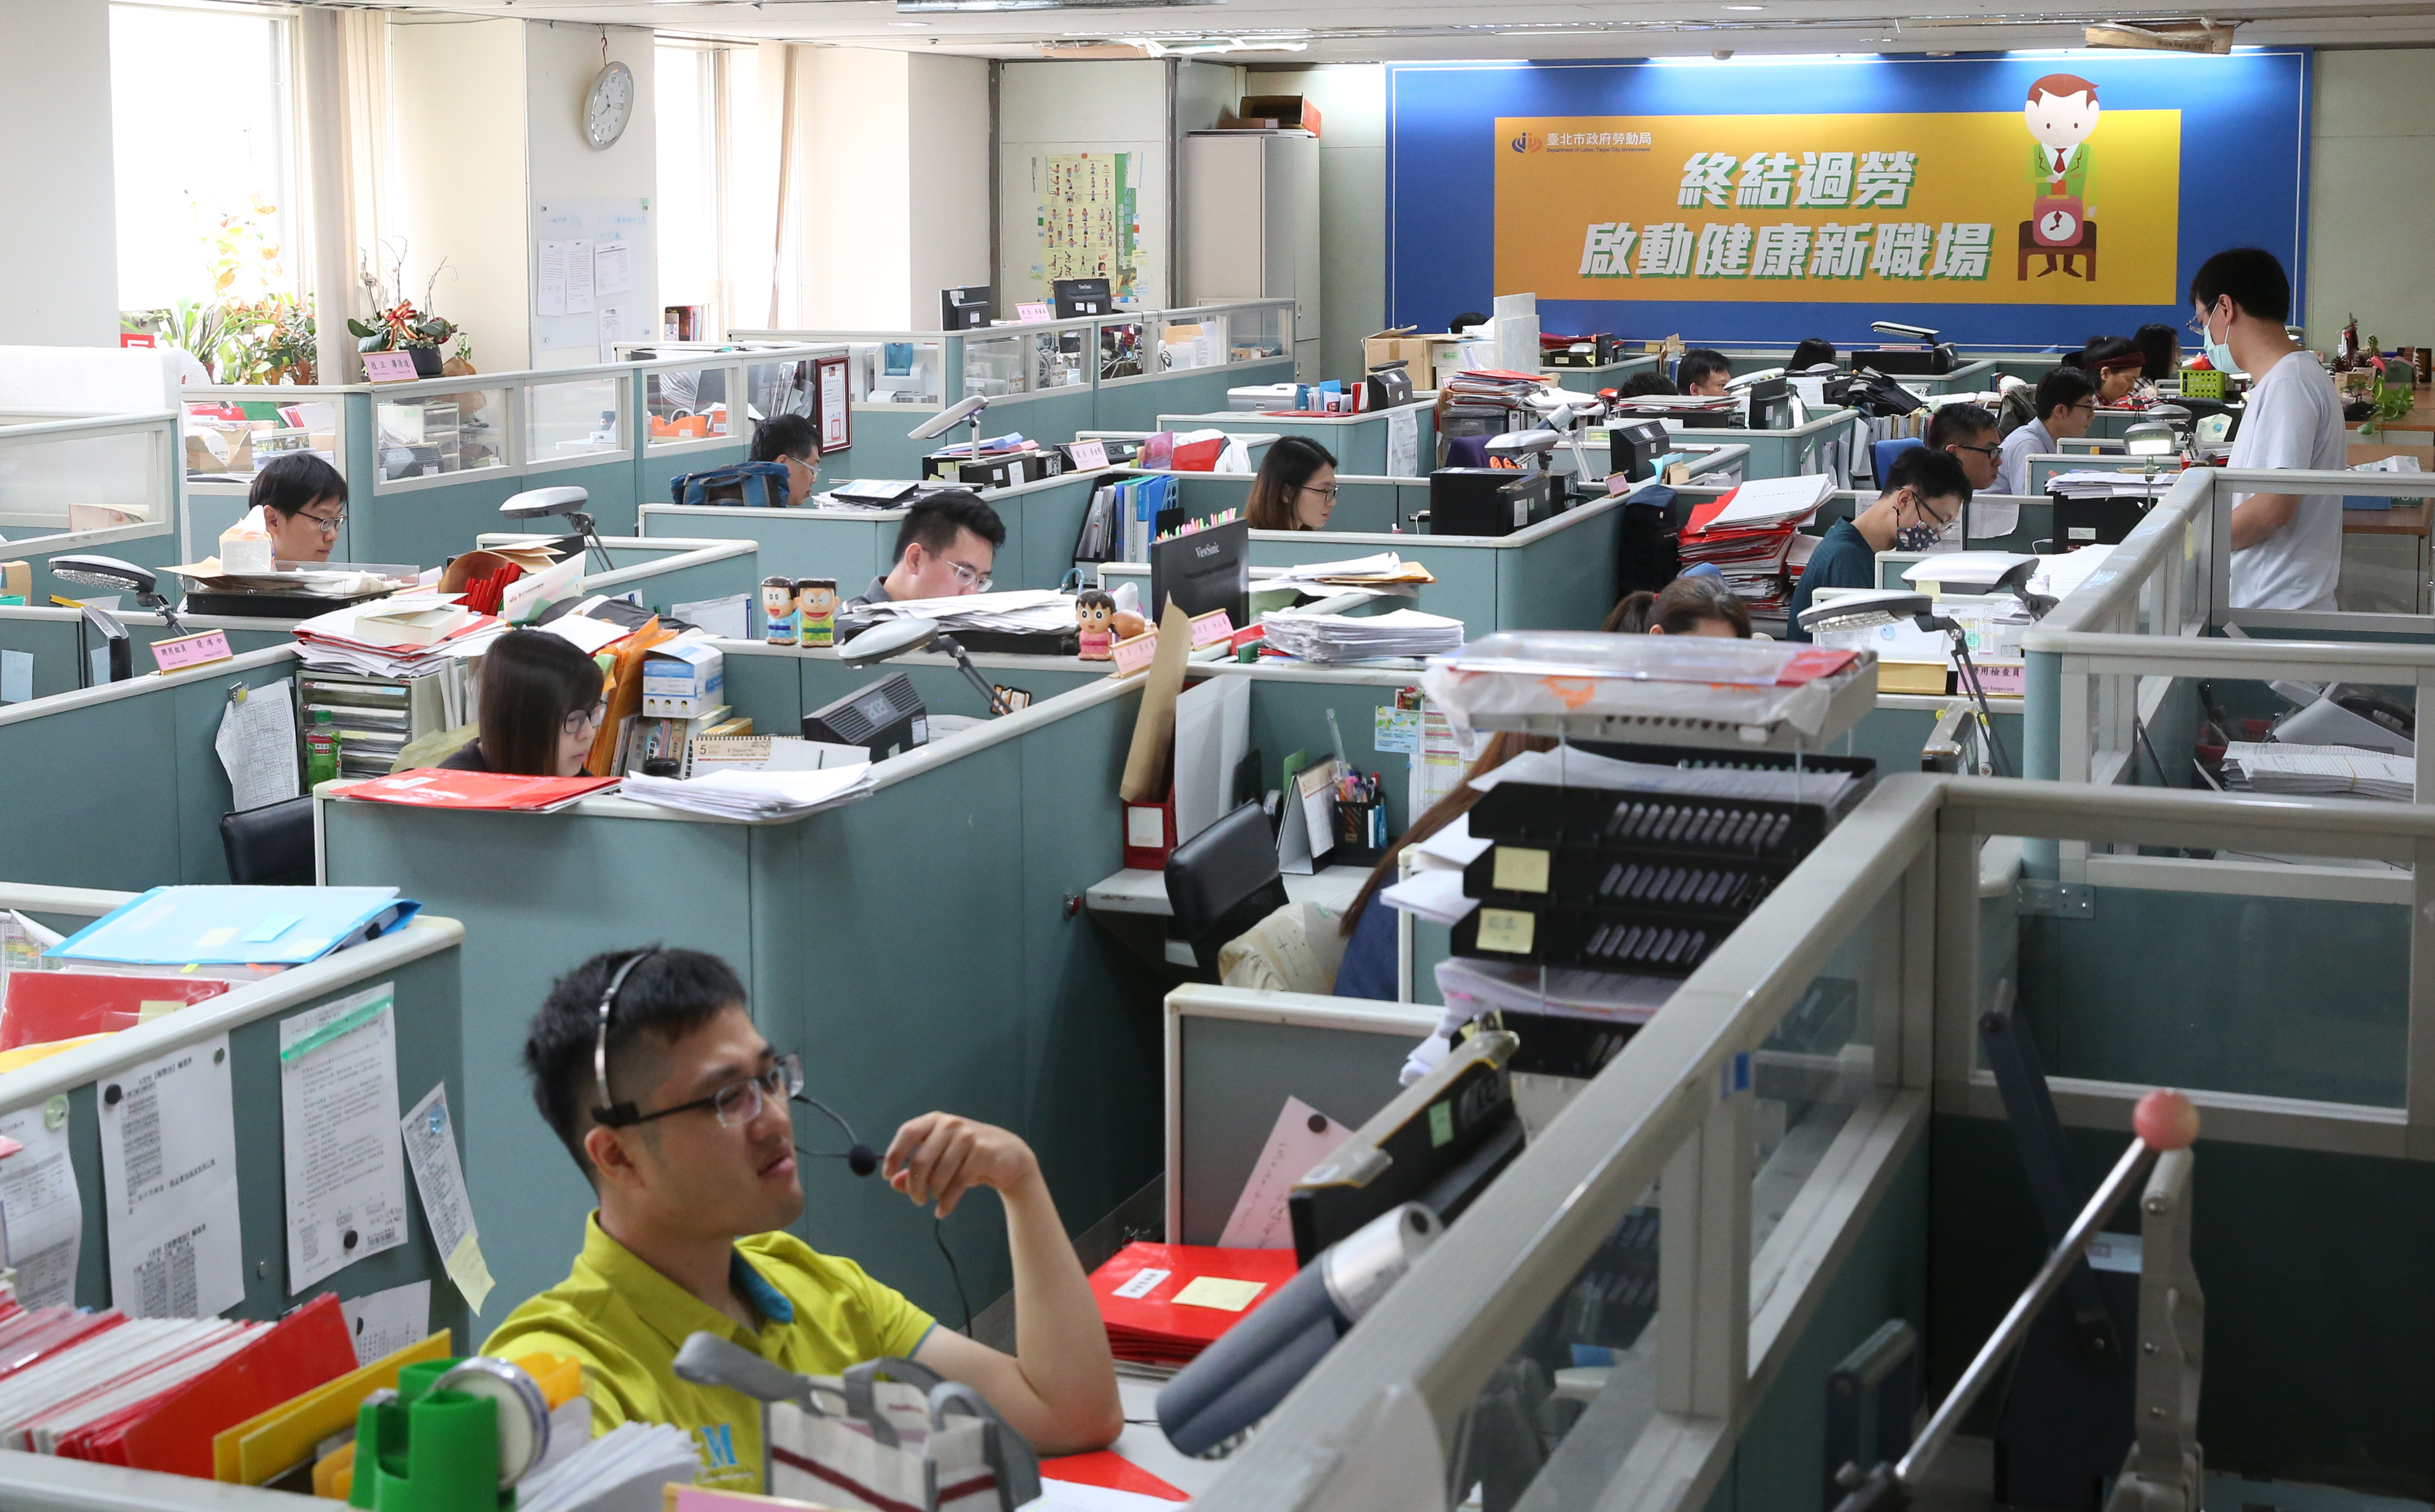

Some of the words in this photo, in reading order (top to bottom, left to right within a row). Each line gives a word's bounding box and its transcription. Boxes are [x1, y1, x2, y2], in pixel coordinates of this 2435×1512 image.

[1547, 132, 1651, 145] 臺北市政府勞動局
[1677, 152, 1916, 208] 終結過勞
[1578, 222, 1993, 280] 啟動健康新職場
[1196, 542, 1220, 559] ViewSonic
[700, 745, 707, 755] 5
